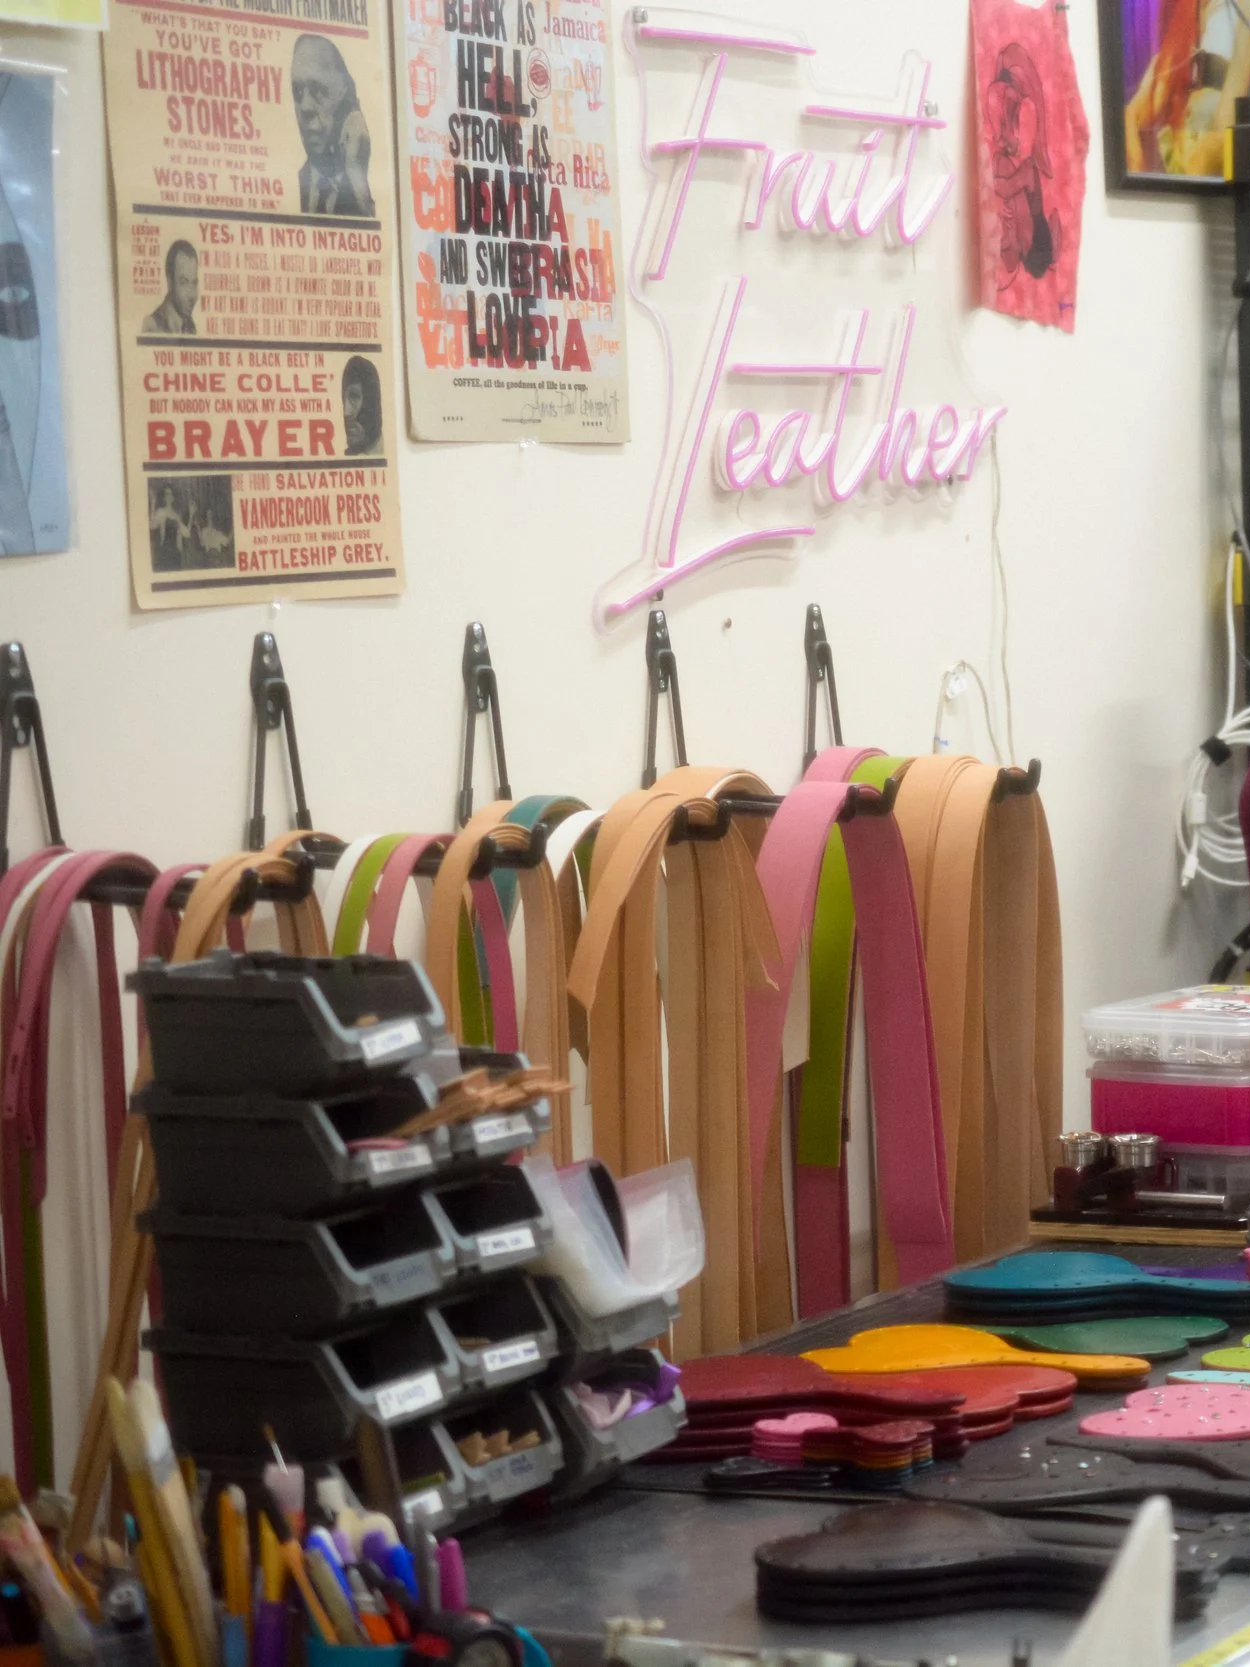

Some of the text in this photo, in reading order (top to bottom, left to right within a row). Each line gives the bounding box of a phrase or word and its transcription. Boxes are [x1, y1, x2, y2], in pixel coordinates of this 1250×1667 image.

[192, 16, 220, 33] THAT
[225, 23, 248, 37] YOU
[252, 27, 281, 42] SAY?
[444, 0, 537, 46] BLACK AS
[544, 1, 607, 43] Jamaica
[156, 29, 263, 60] YOU'VE GOT
[136, 48, 283, 105] LITHOGRAPHY
[456, 38, 538, 117] HELL,
[449, 113, 523, 168] STRONG
[532, 124, 549, 170] AS
[640, 26, 955, 281] Fruit
[153, 168, 284, 196] WORST THING
[205, 195, 243, 207] HAPPENED
[453, 164, 550, 240] DEATH
[240, 226, 264, 246] I'M
[271, 228, 306, 249] INTO
[313, 231, 382, 254] INTAGLIO
[440, 239, 468, 285] AND
[467, 290, 546, 362] LOVE
[154, 351, 324, 368] YOU MIGHT BE A BLACK BELT IN
[143, 372, 226, 393] CHINE
[484, 379, 492, 388] all
[494, 379, 505, 389] the
[538, 381, 545, 390] of
[546, 381, 558, 390] life
[559, 382, 567, 390] in
[150, 398, 332, 414] BUT NOBODY CAN KICK MY ASS WITH A
[147, 419, 336, 461] BRAYER
[609, 274, 1008, 614] Leather
[276, 470, 365, 491] SALVATION
[370, 470, 377, 486] IN
[240, 493, 382, 530] VANDERCOOK PRESS
[253, 529, 371, 545] AND PAINTED THE WHOLE HOUSE
[238, 543, 389, 572] BATTLESHIP GREY.
